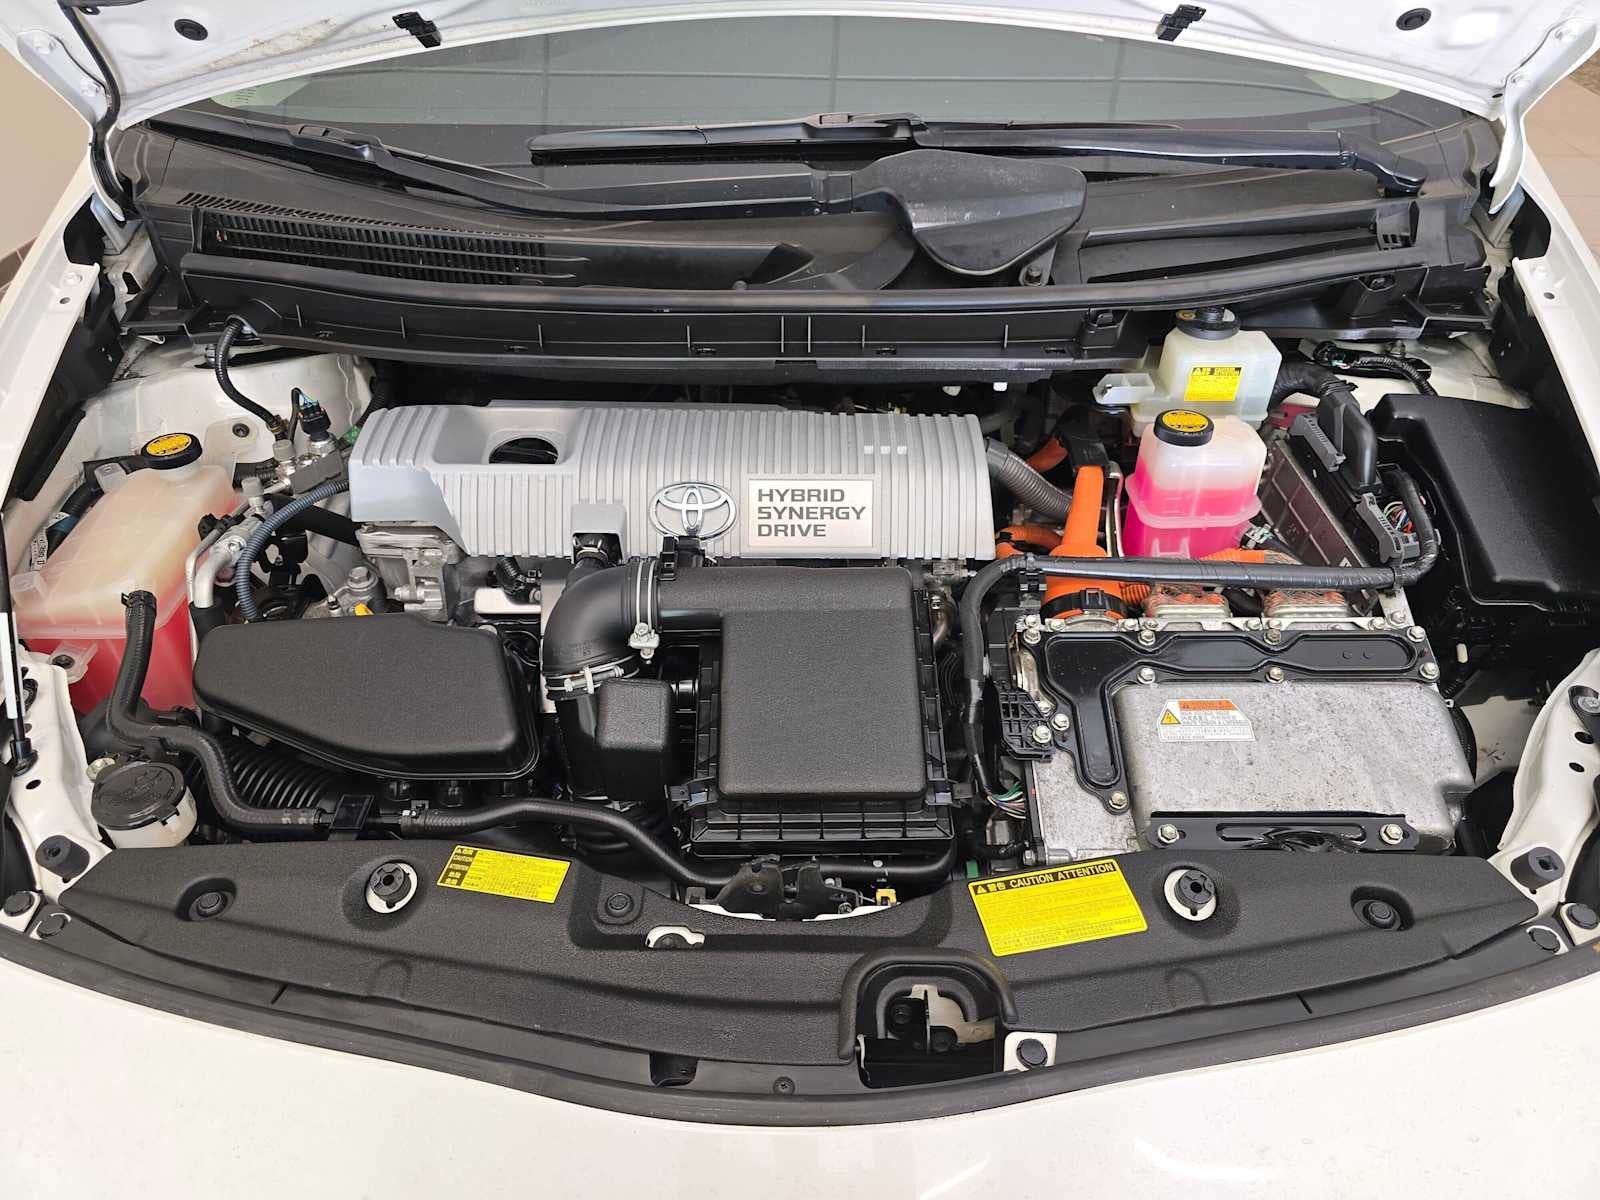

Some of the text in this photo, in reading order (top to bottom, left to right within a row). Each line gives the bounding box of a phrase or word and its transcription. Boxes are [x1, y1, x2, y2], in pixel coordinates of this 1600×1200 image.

[757, 488, 845, 502] HYBRID
[757, 506, 866, 520] SYNERGY
[757, 524, 827, 537] DRIVE
[1009, 873, 1054, 888] CAUTION
[1057, 863, 1115, 881] ATTENTION
